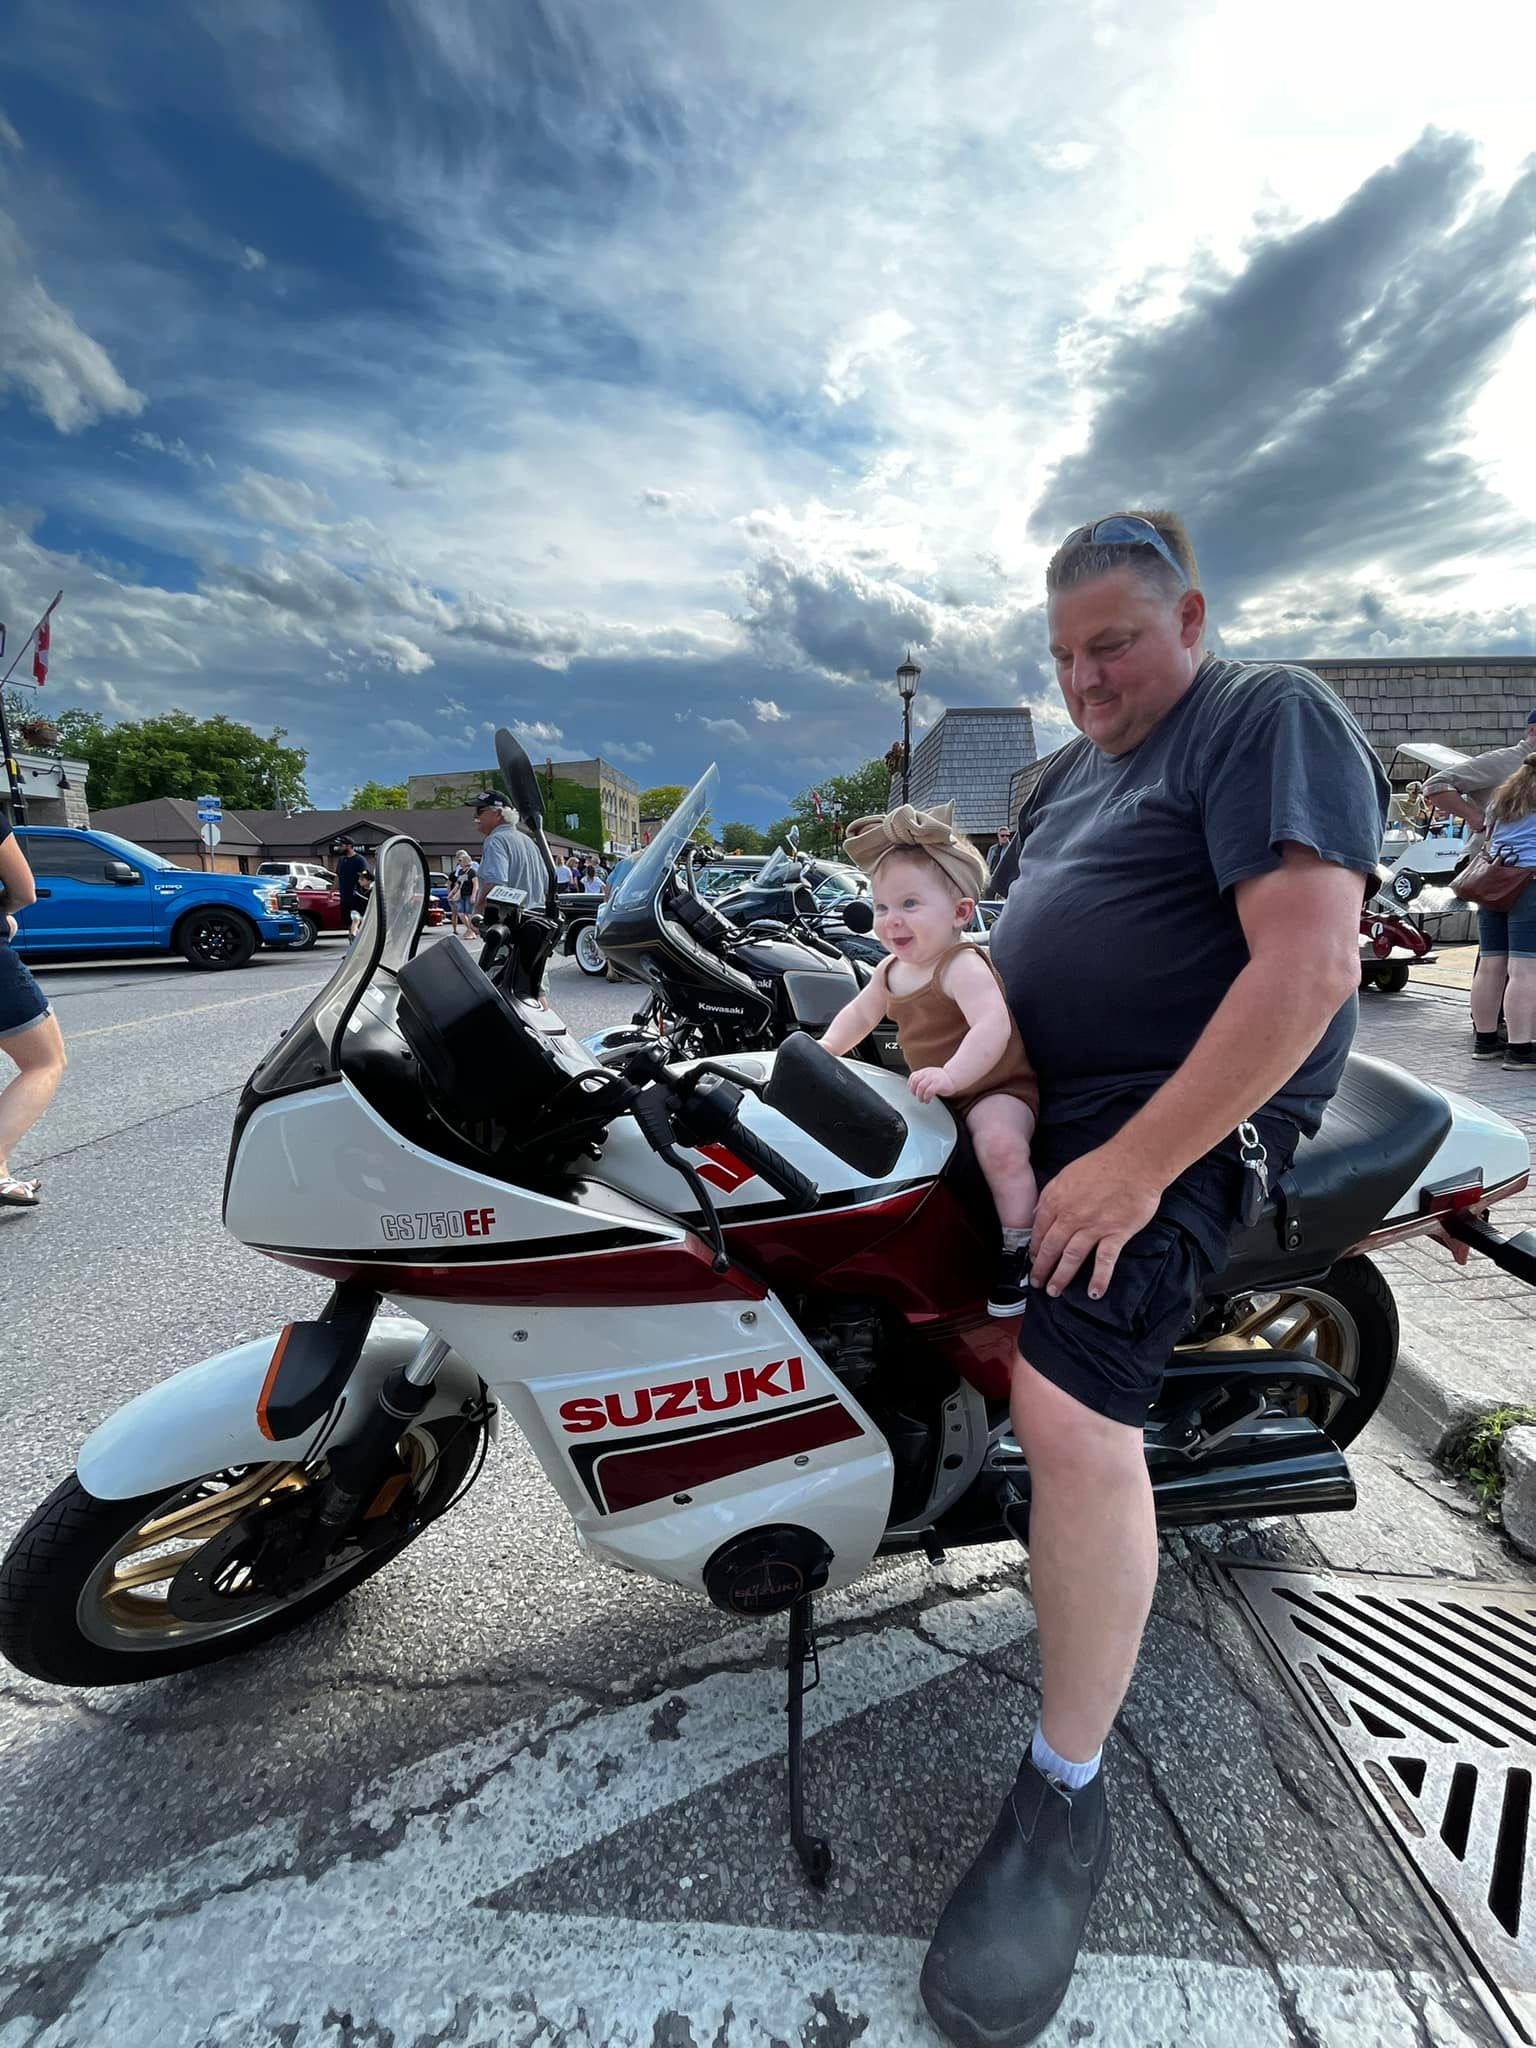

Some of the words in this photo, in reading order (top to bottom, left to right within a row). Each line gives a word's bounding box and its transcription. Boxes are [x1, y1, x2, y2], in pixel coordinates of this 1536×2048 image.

[698, 1002, 744, 1015] Kawasaki
[381, 1208, 496, 1240] GS750EF
[559, 1356, 805, 1434] SUZUKI
